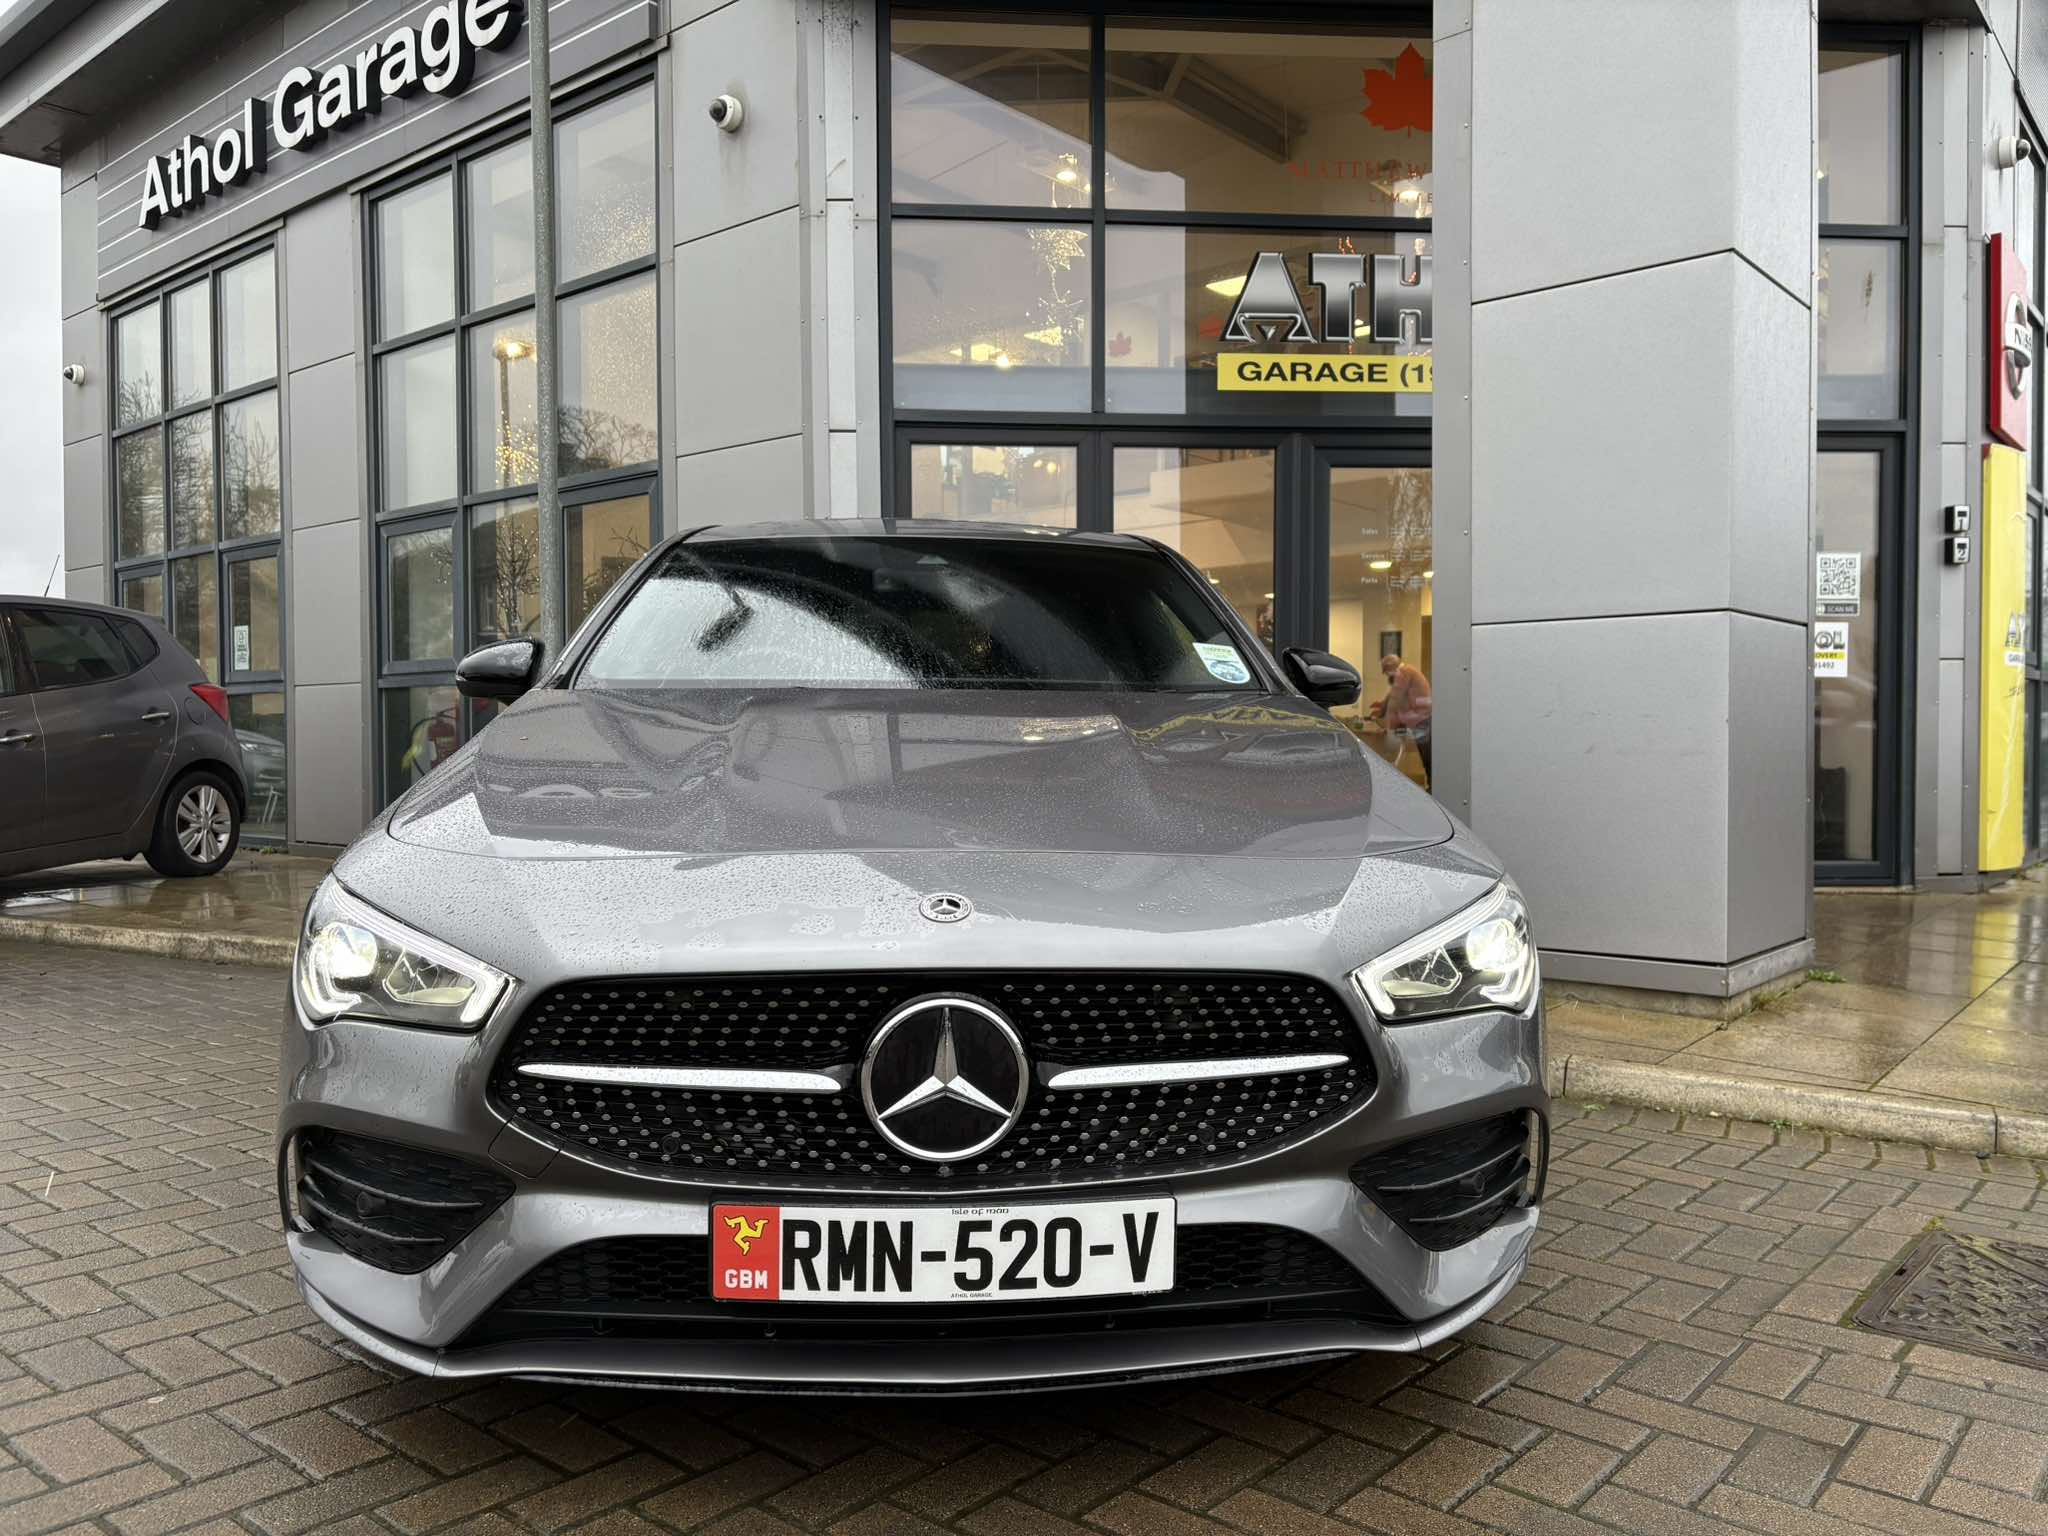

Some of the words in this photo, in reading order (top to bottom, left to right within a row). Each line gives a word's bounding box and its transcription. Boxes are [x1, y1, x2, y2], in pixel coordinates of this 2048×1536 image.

[138, 98, 256, 228] Athol
[272, 0, 512, 149] Garage
[1237, 361, 1388, 382] GARAGE
[1957, 550, 1966, 561] 2
[951, 1208, 969, 1216] Isle
[970, 1208, 984, 1217] of
[782, 1211, 1160, 1292] RMN-520-V
[724, 1268, 768, 1290] GBM
